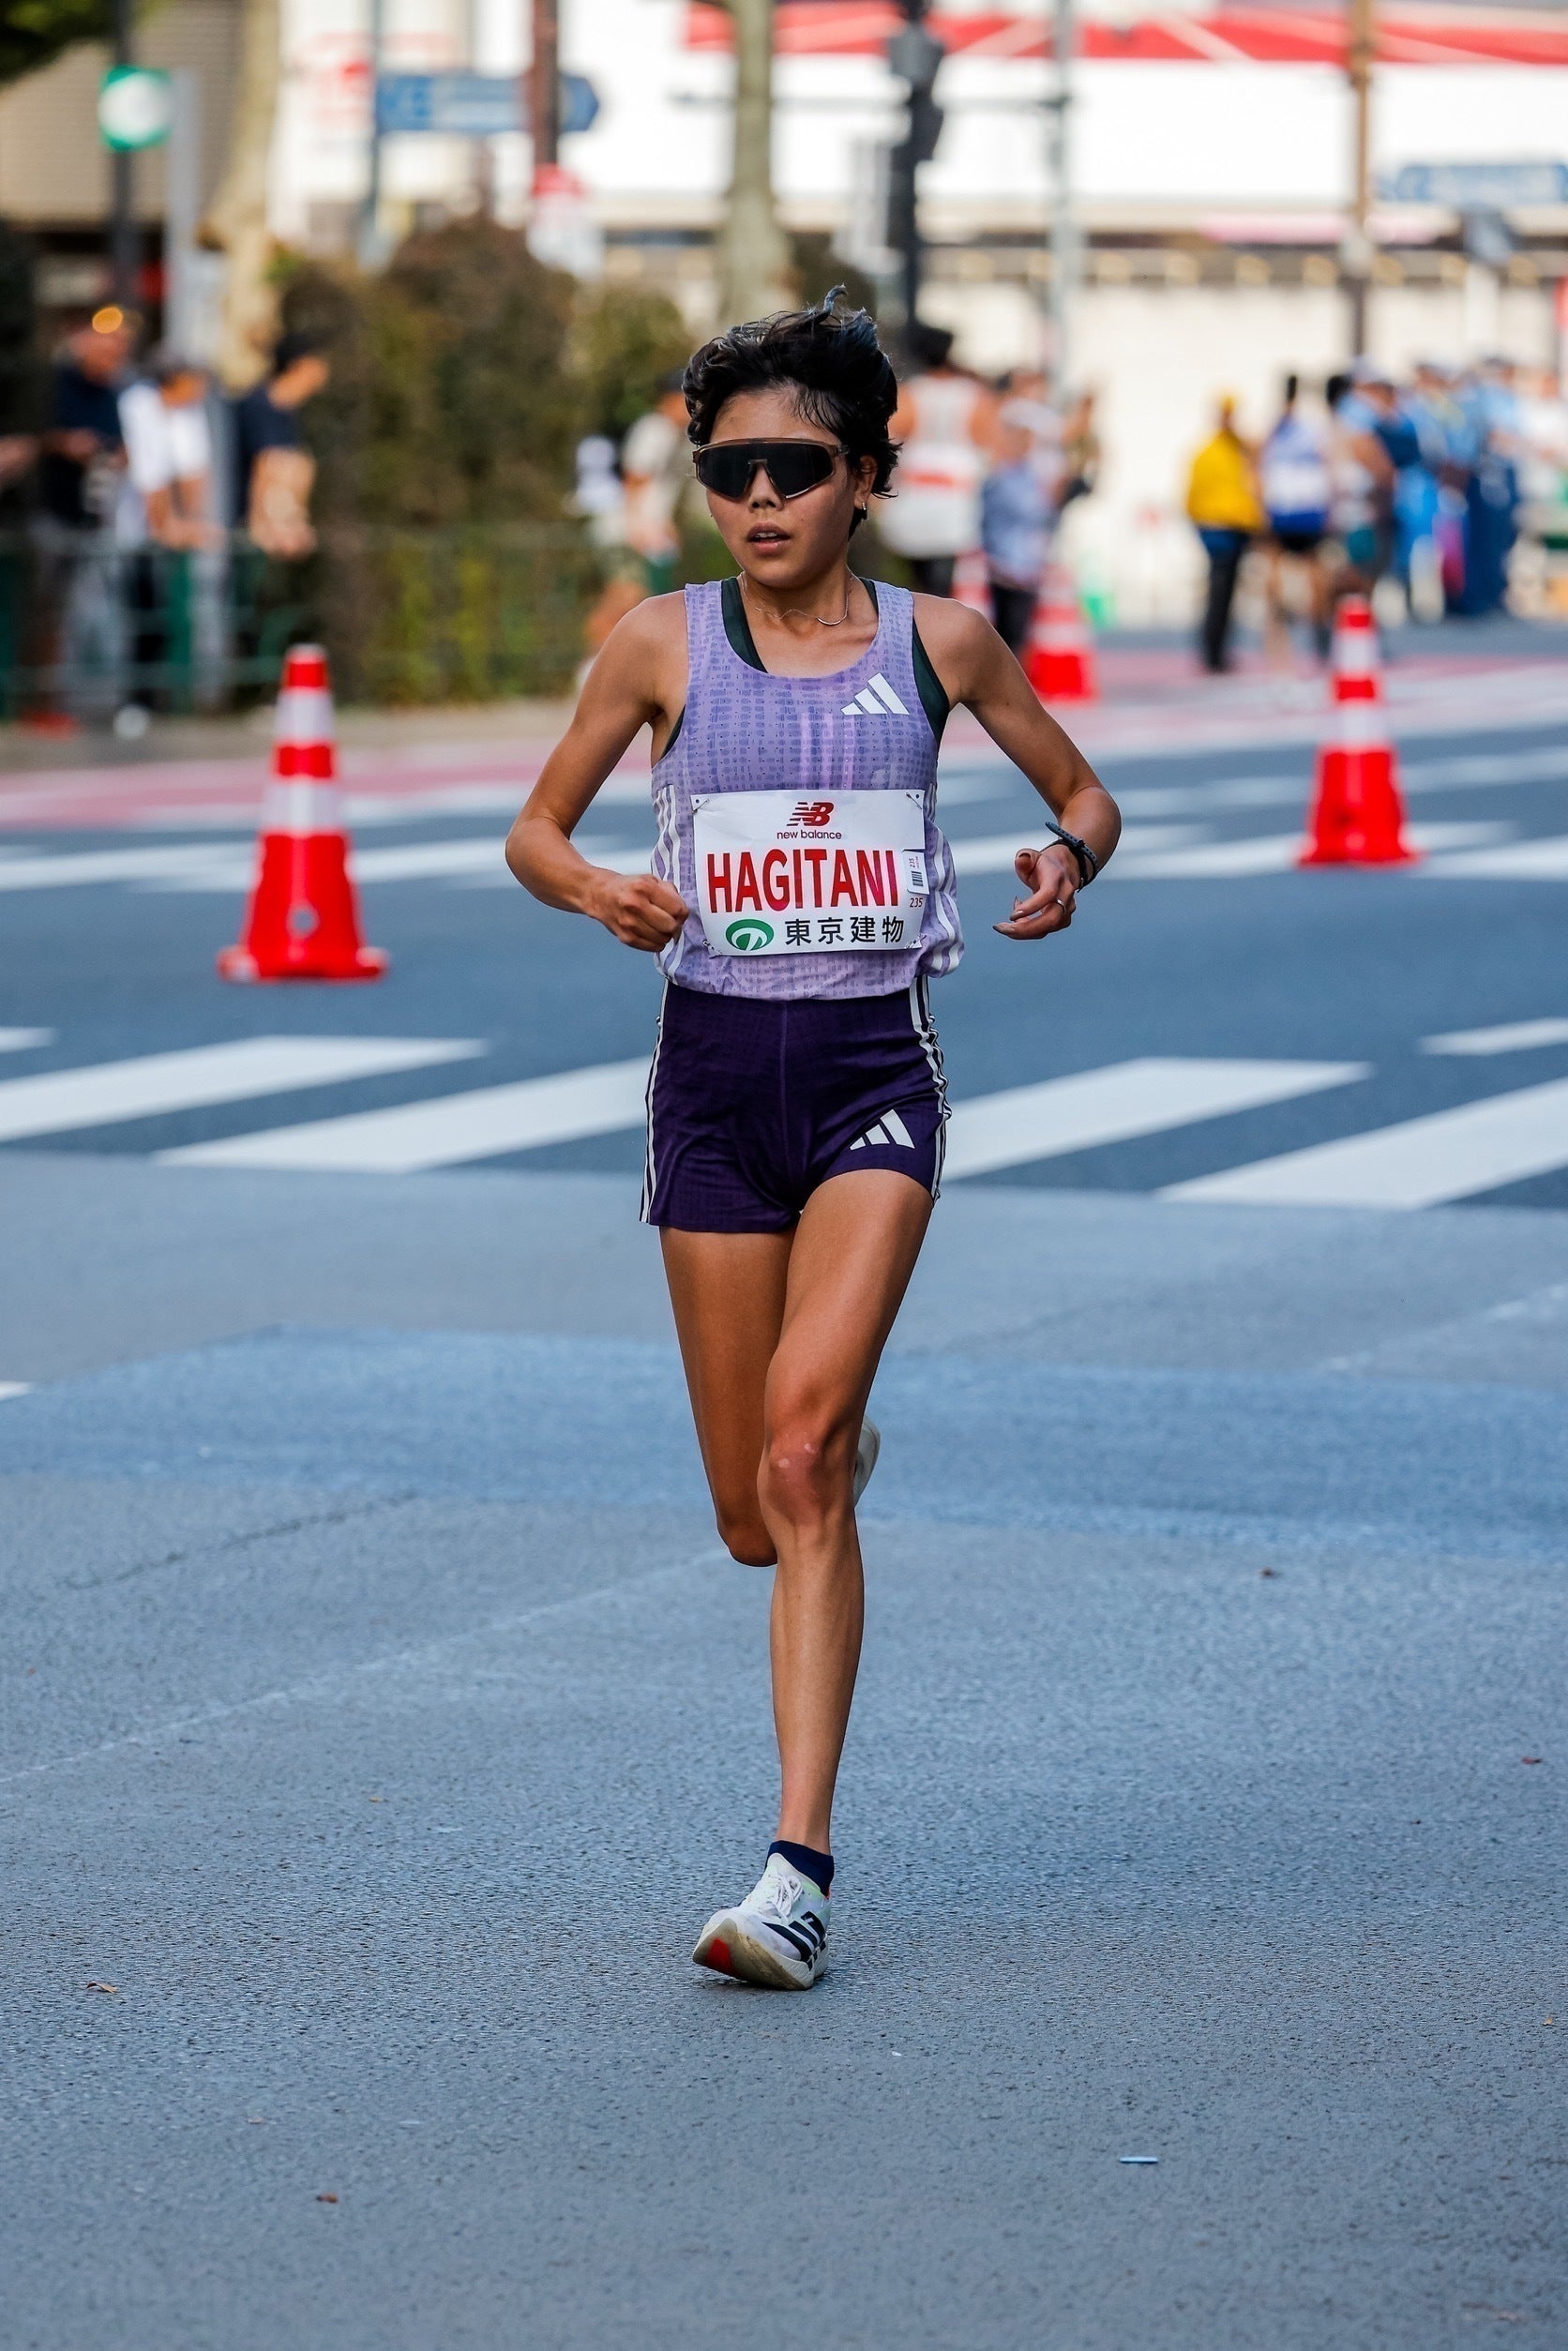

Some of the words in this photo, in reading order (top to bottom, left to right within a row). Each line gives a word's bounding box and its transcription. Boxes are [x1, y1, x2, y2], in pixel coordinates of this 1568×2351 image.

[776, 831, 798, 839] new
[801, 829, 842, 839] balance
[706, 849, 899, 913] HAGITANI
[909, 897, 924, 908] 235
[784, 915, 905, 946] 東京建物
